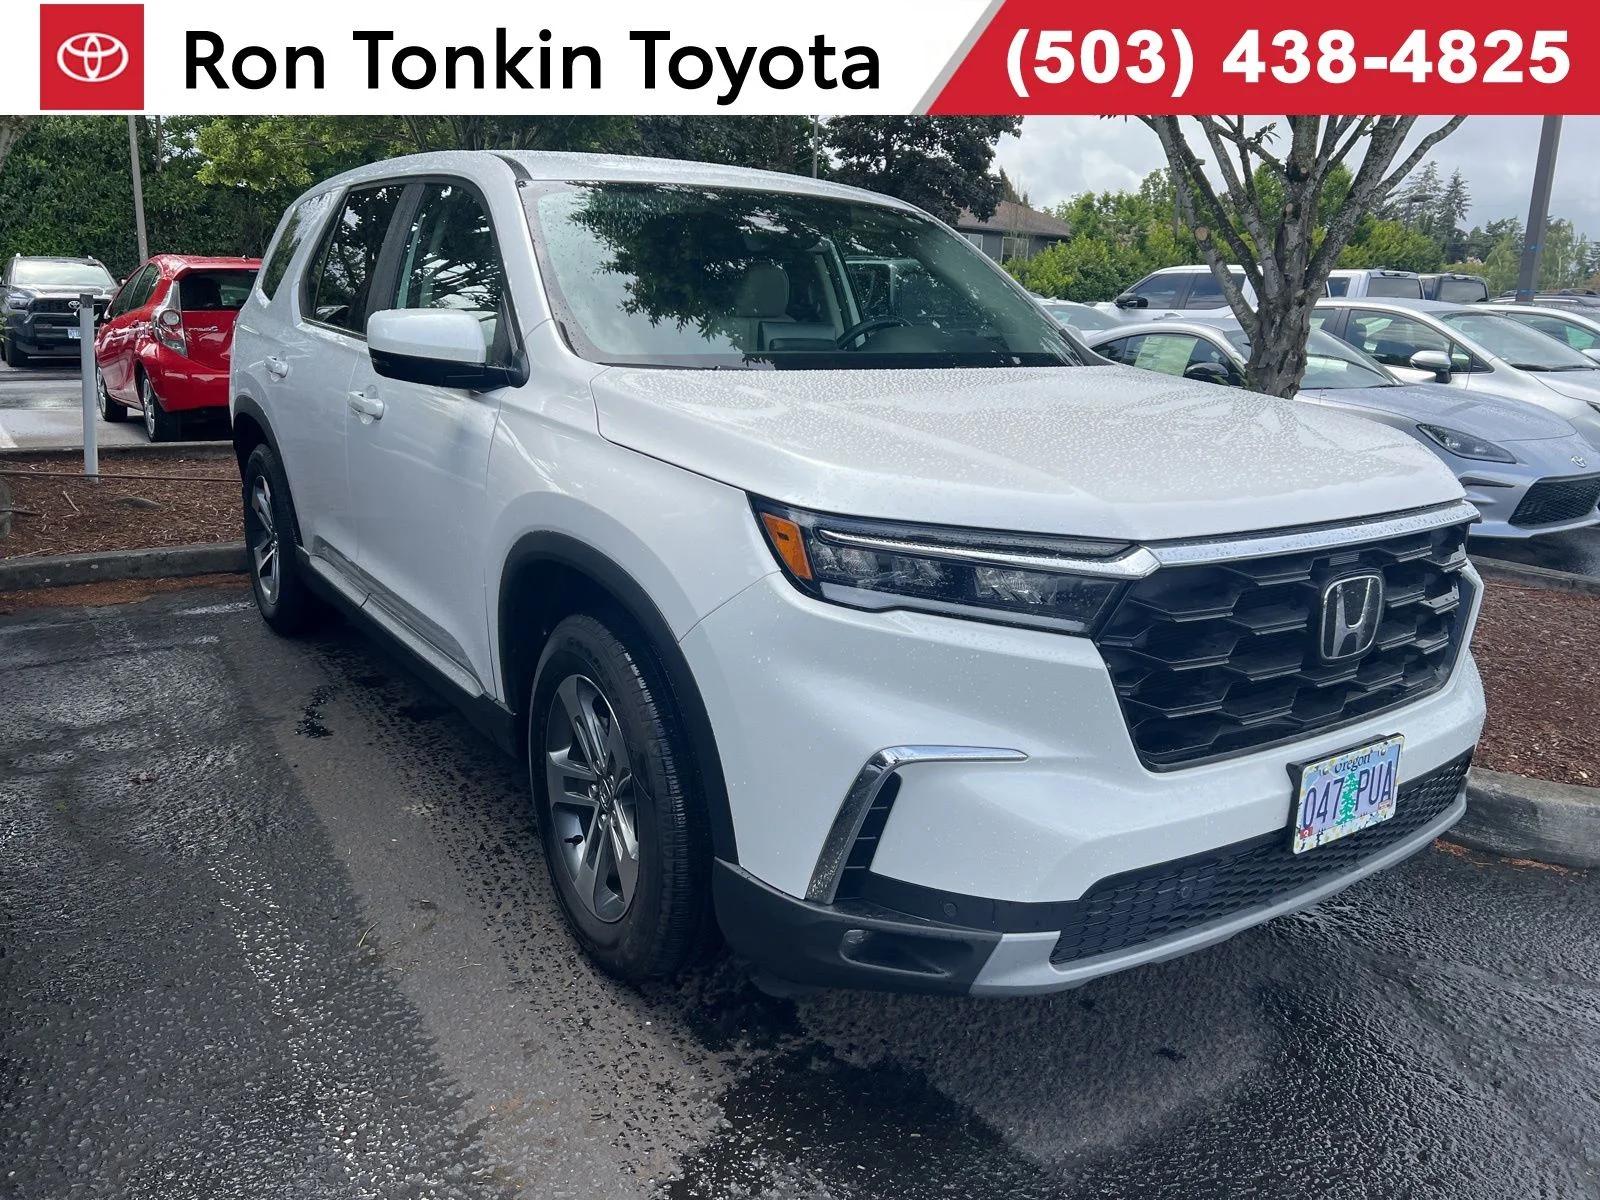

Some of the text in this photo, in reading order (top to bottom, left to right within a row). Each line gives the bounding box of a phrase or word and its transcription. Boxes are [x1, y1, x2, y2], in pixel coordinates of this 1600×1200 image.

[1334, 754, 1371, 773] Oregon
[1304, 762, 1393, 828] 047 PUA
